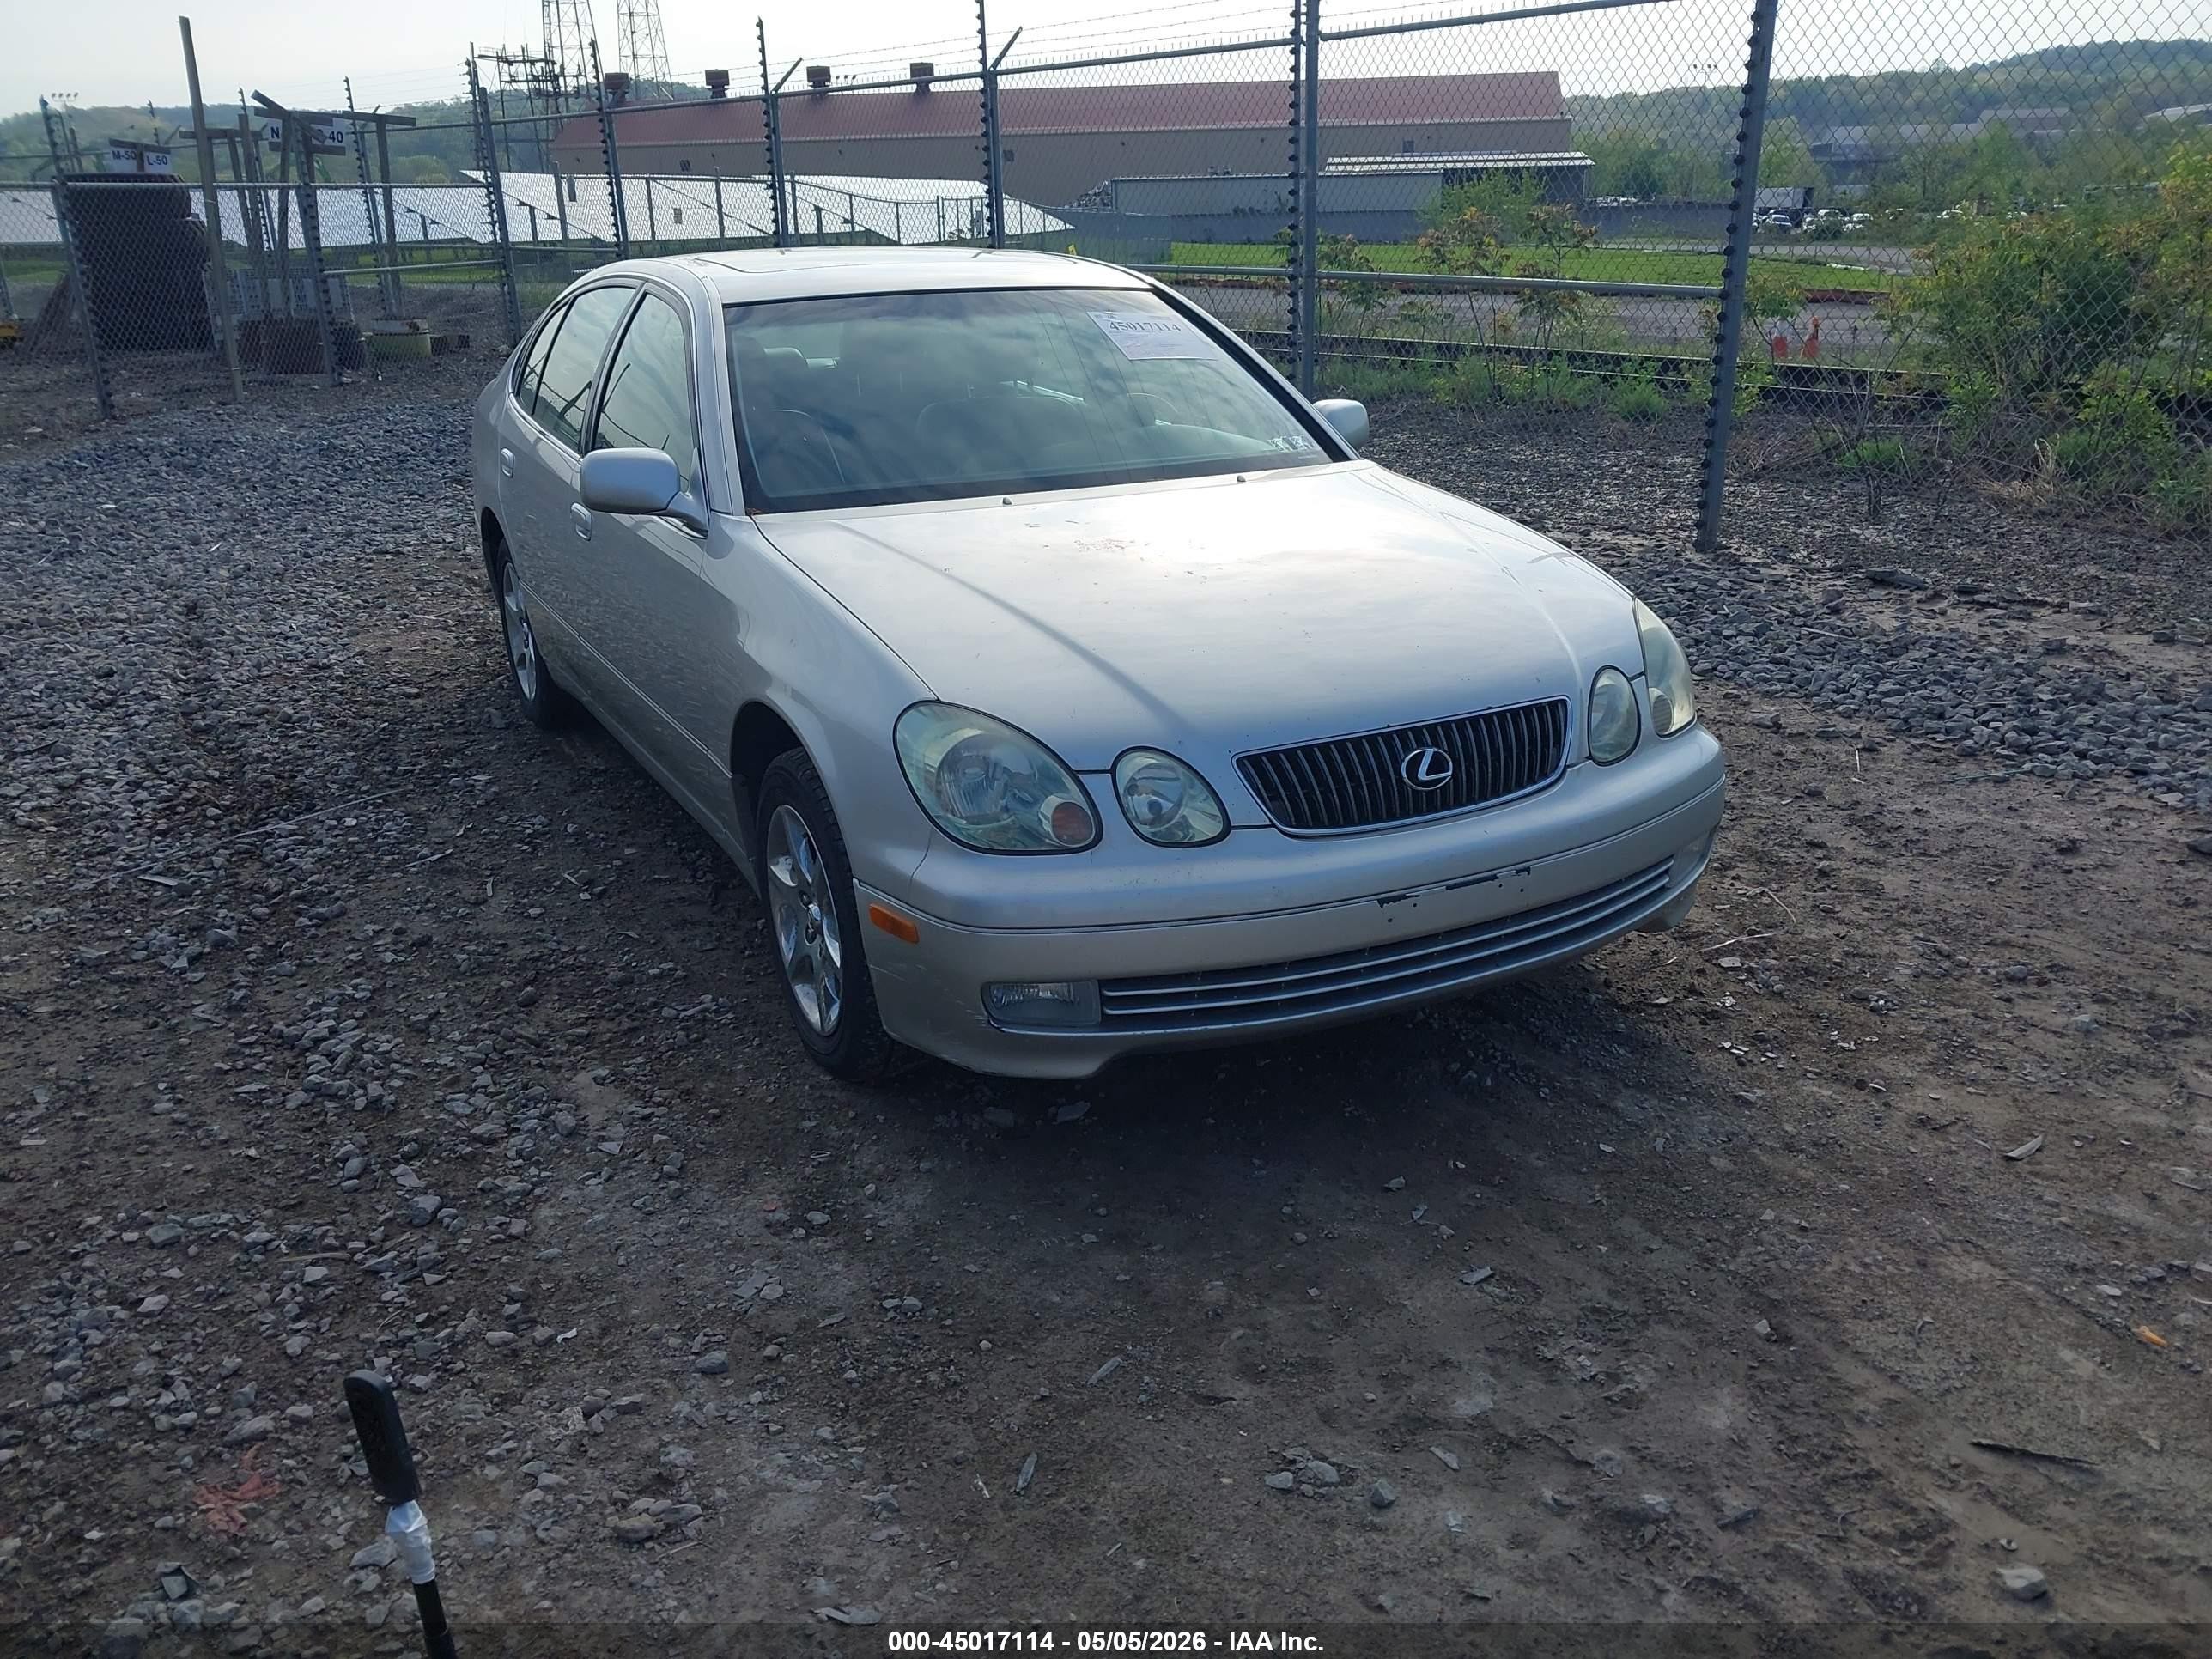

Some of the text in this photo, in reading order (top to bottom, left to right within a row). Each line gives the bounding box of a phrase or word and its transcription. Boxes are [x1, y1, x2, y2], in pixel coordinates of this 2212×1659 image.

[112, 150, 137, 160] M-50
[146, 155, 168, 165] L-50
[1109, 321, 1182, 331] 45017114
